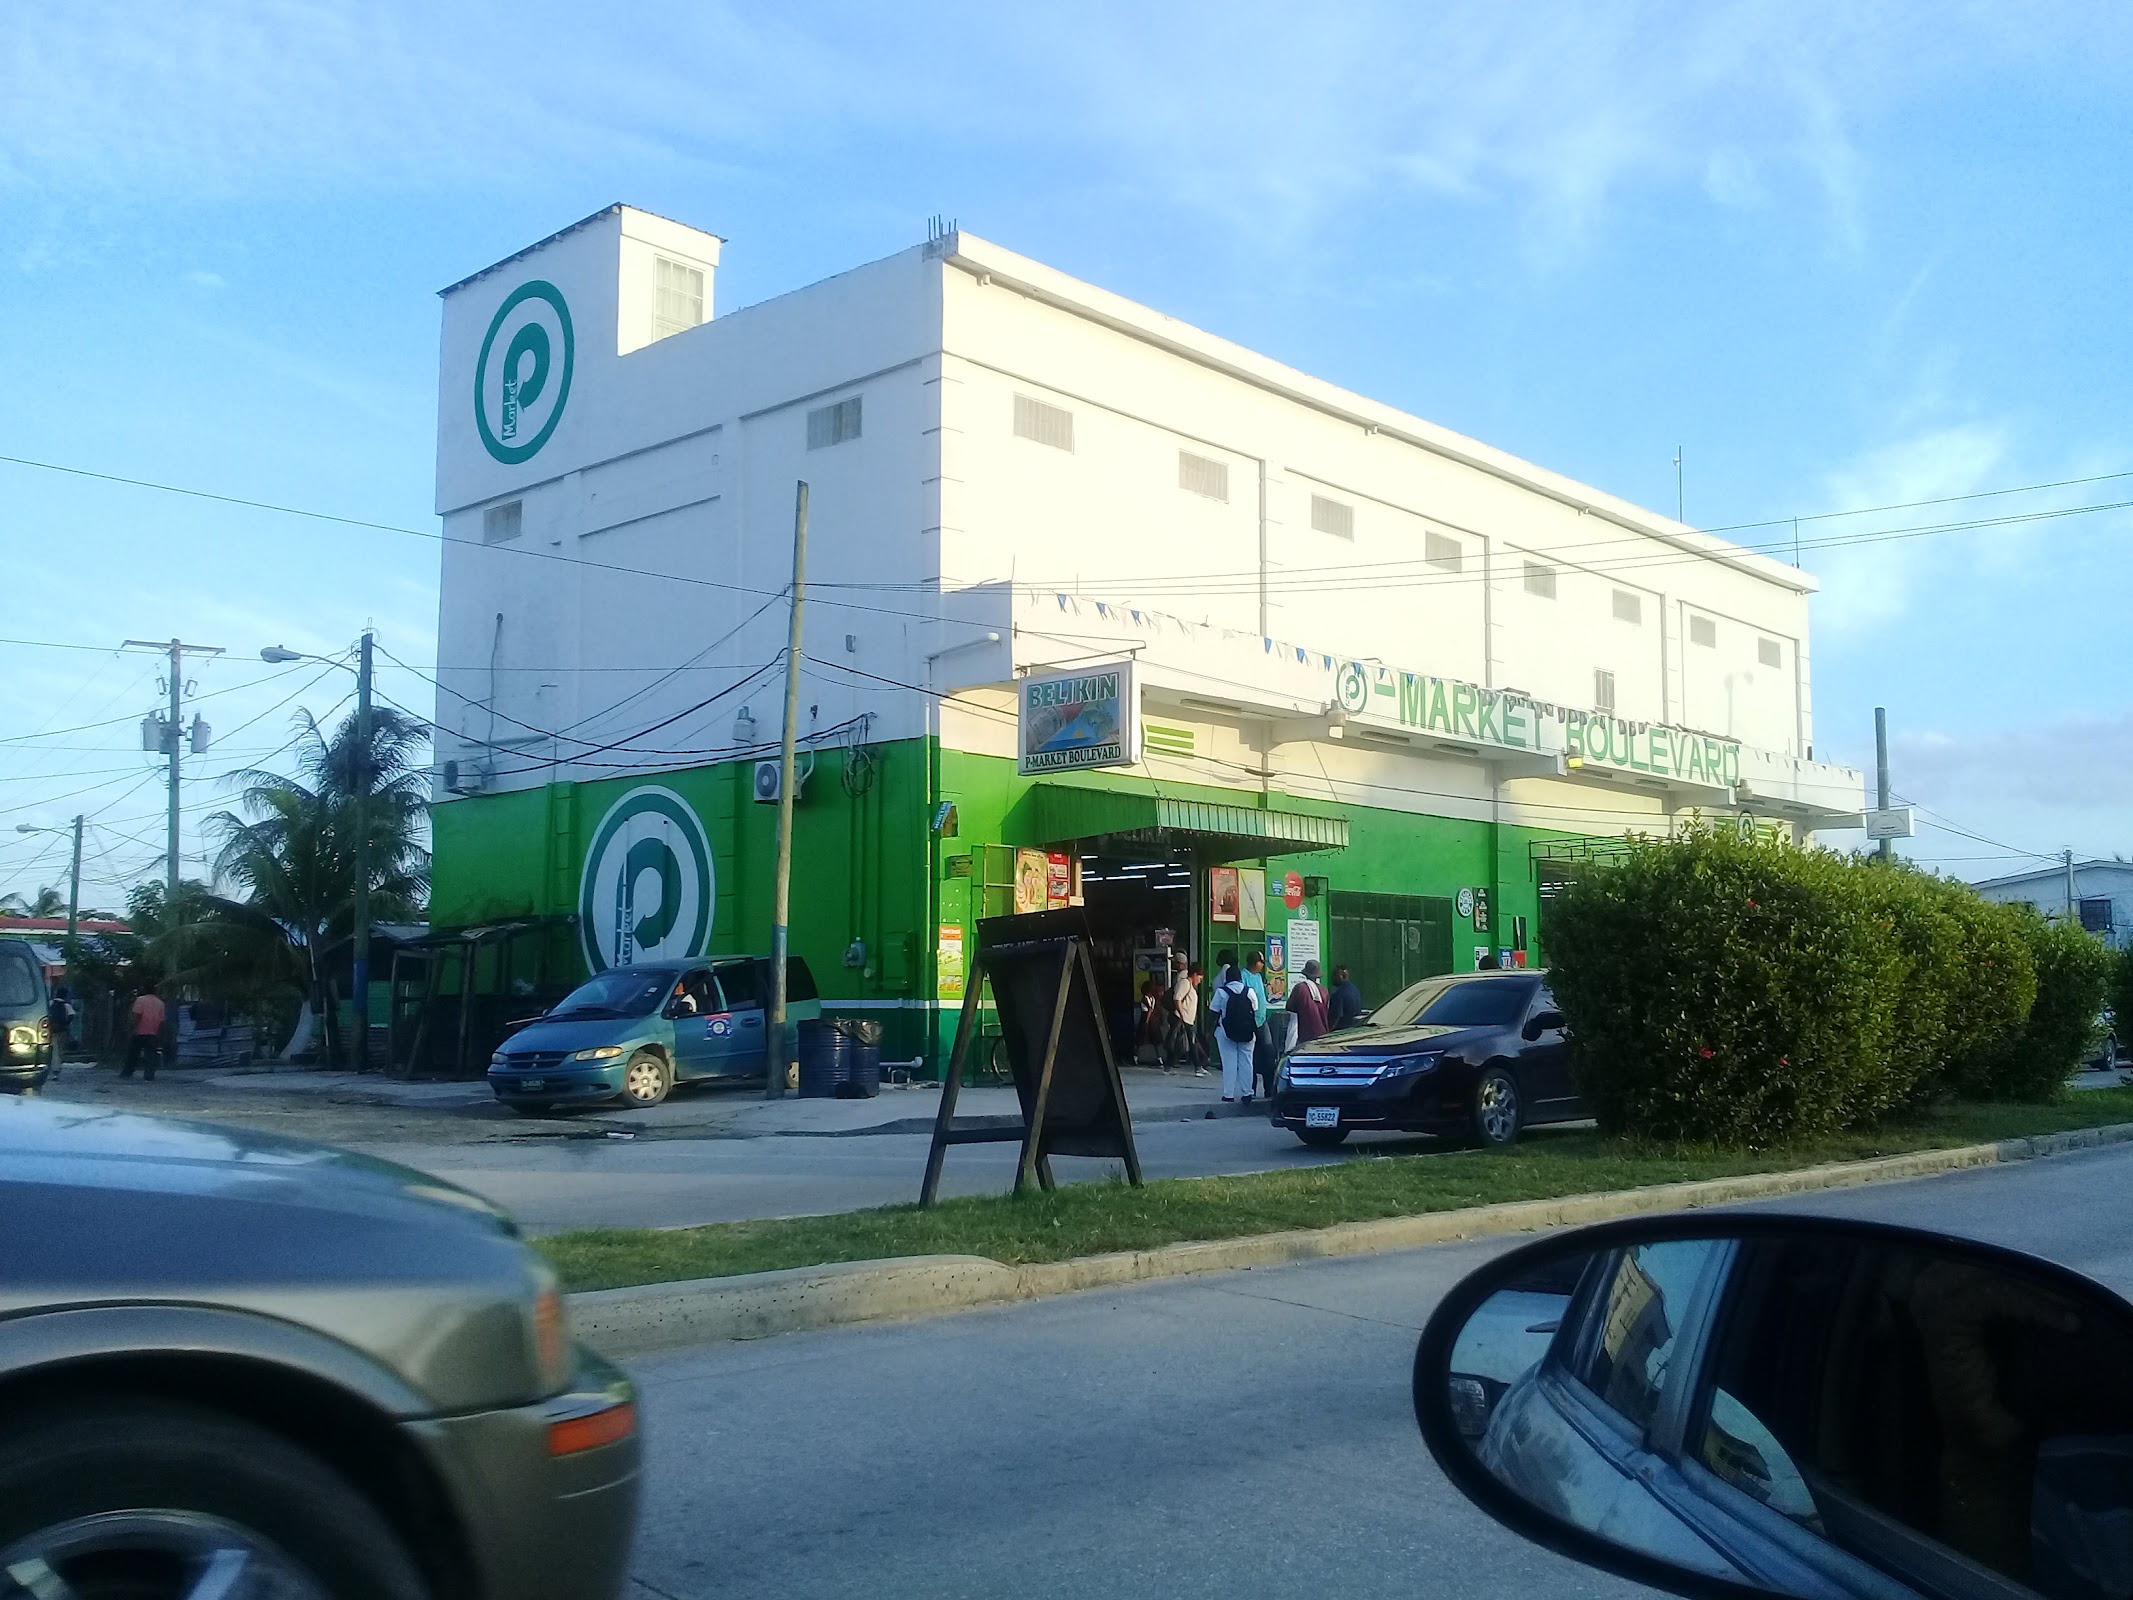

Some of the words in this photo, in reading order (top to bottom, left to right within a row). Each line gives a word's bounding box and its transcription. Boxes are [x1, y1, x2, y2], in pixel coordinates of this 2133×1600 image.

[503, 380, 518, 438] Market
[1027, 672, 1120, 710] BELIKIN
[1025, 750, 1067, 769] P-MARKET
[1068, 744, 1121, 764] BOULEVARD
[1567, 708, 1740, 787] BOULEVARD
